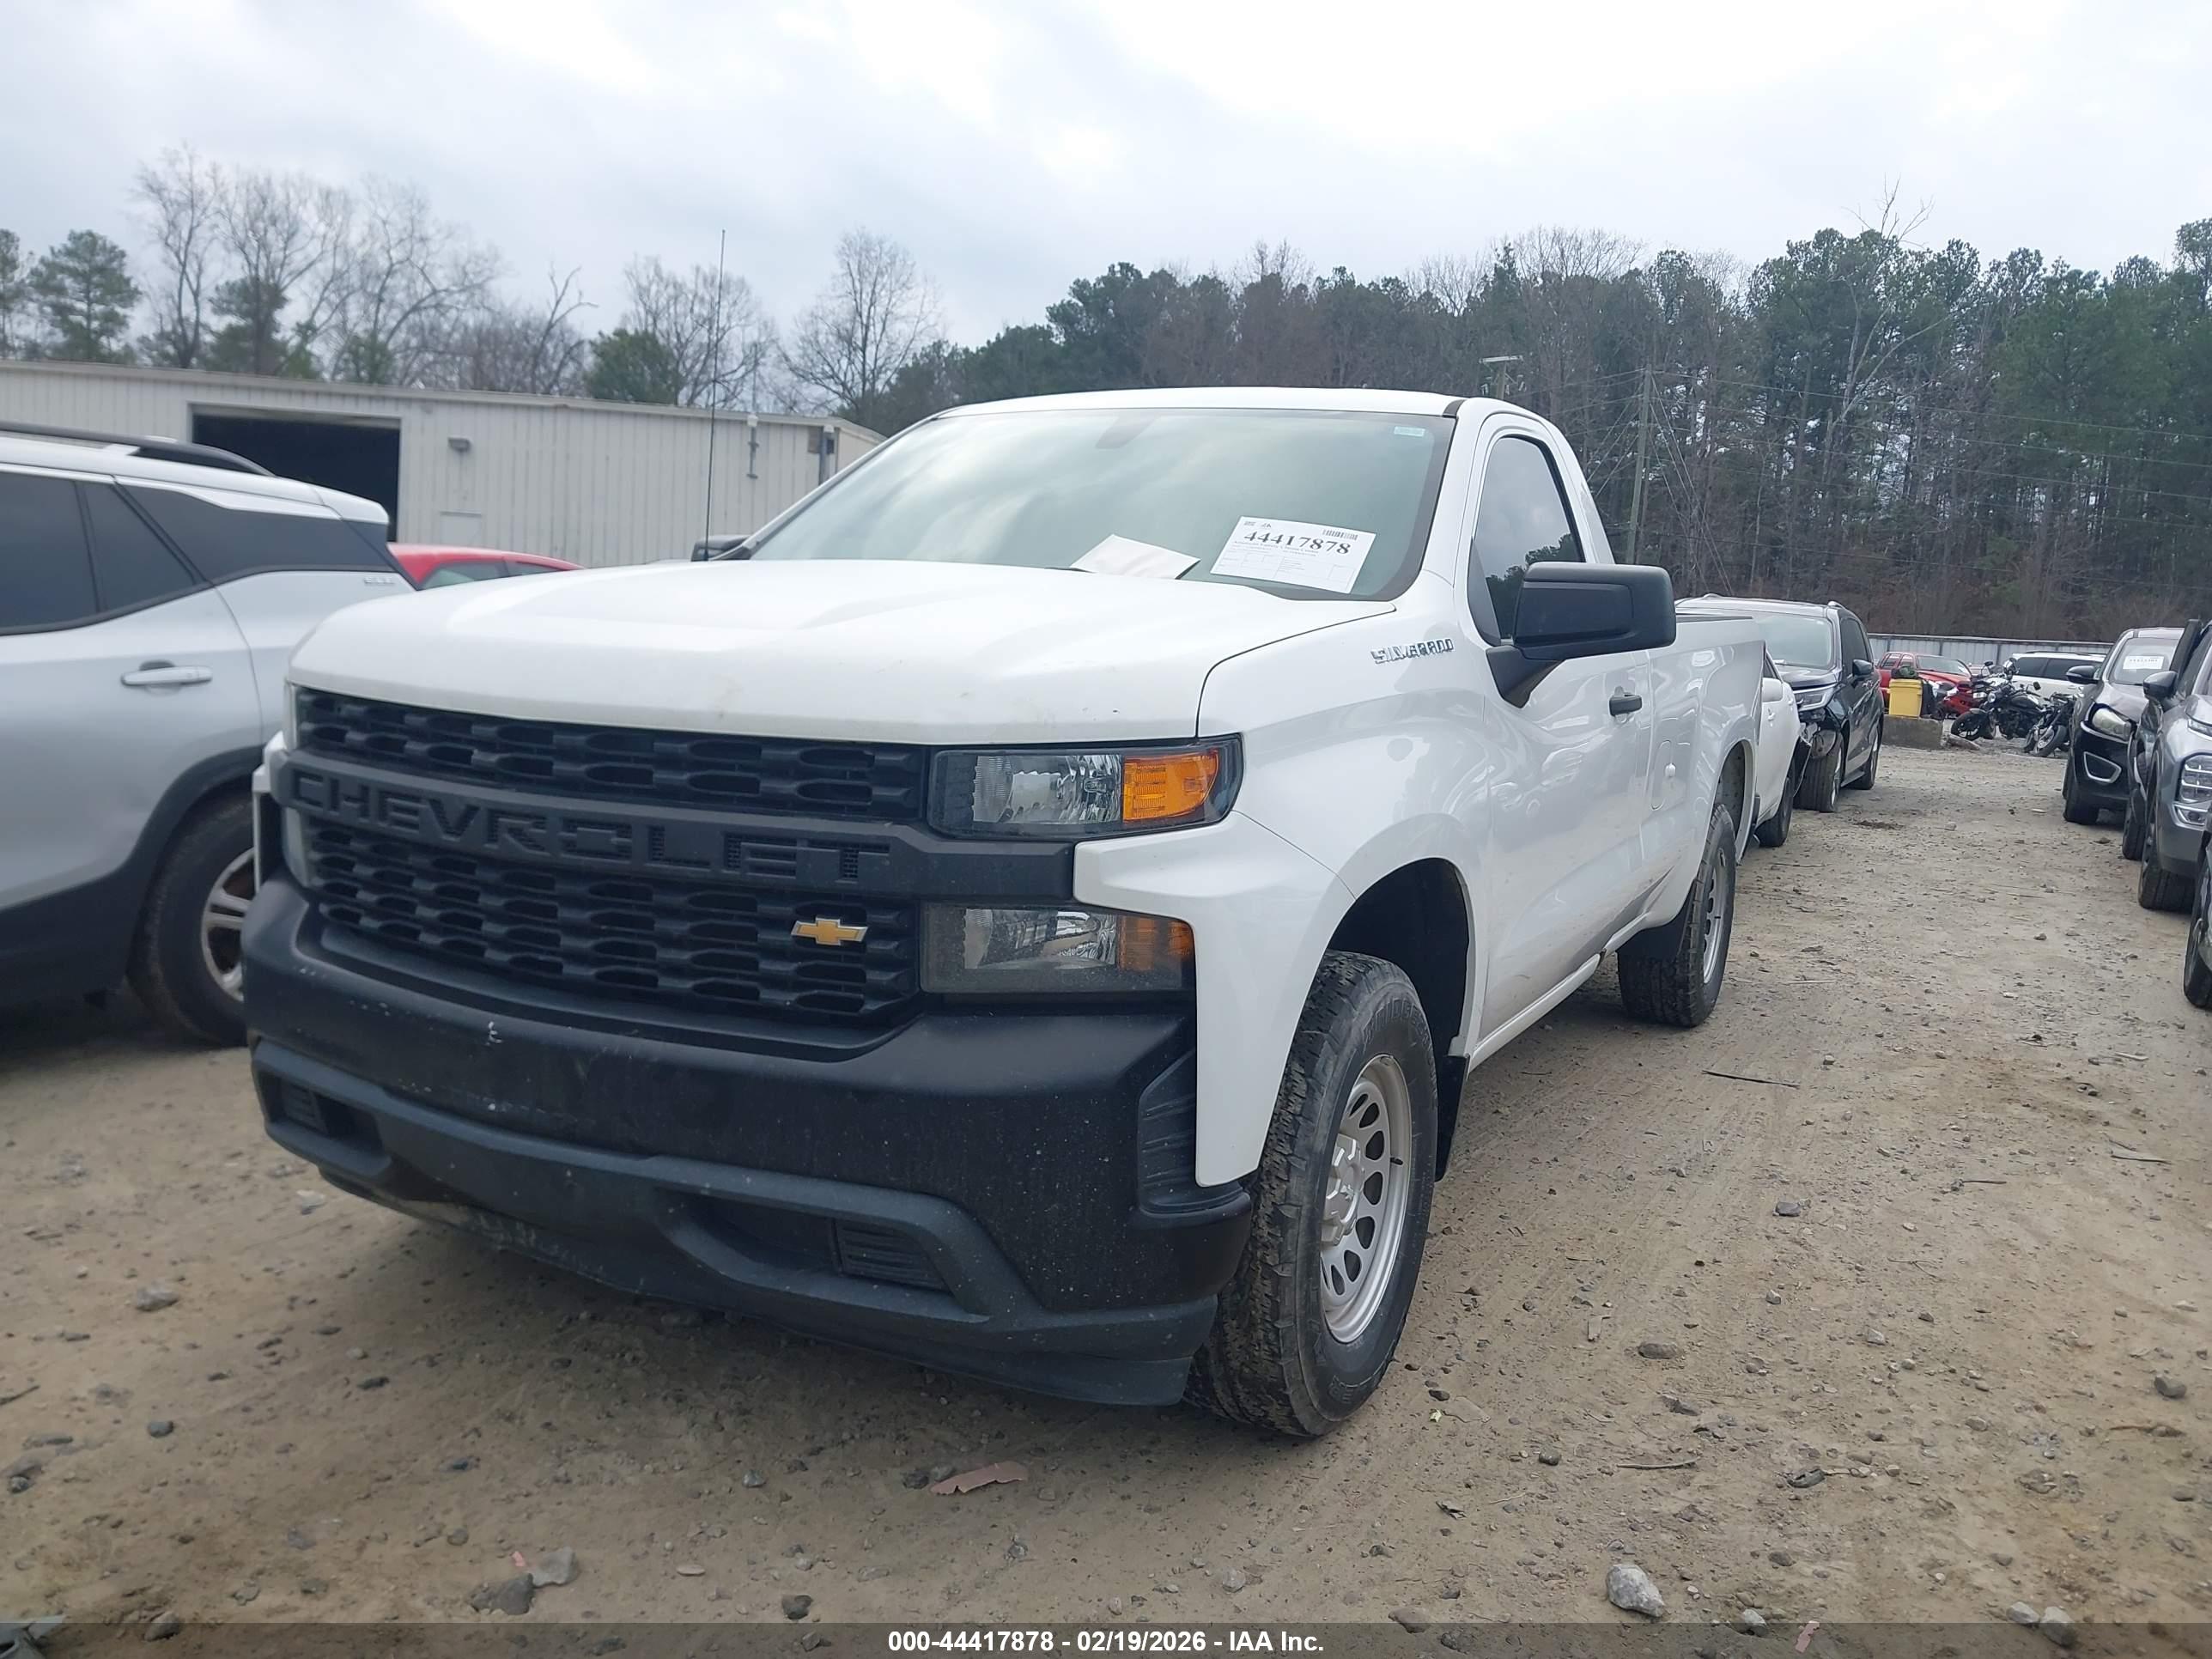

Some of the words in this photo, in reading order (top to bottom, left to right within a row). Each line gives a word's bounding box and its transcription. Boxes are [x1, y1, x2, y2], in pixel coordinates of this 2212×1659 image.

[1243, 530, 1352, 556] 44417878
[1370, 638, 1455, 665] SILVERADO
[290, 770, 890, 884] CHEVROLET
